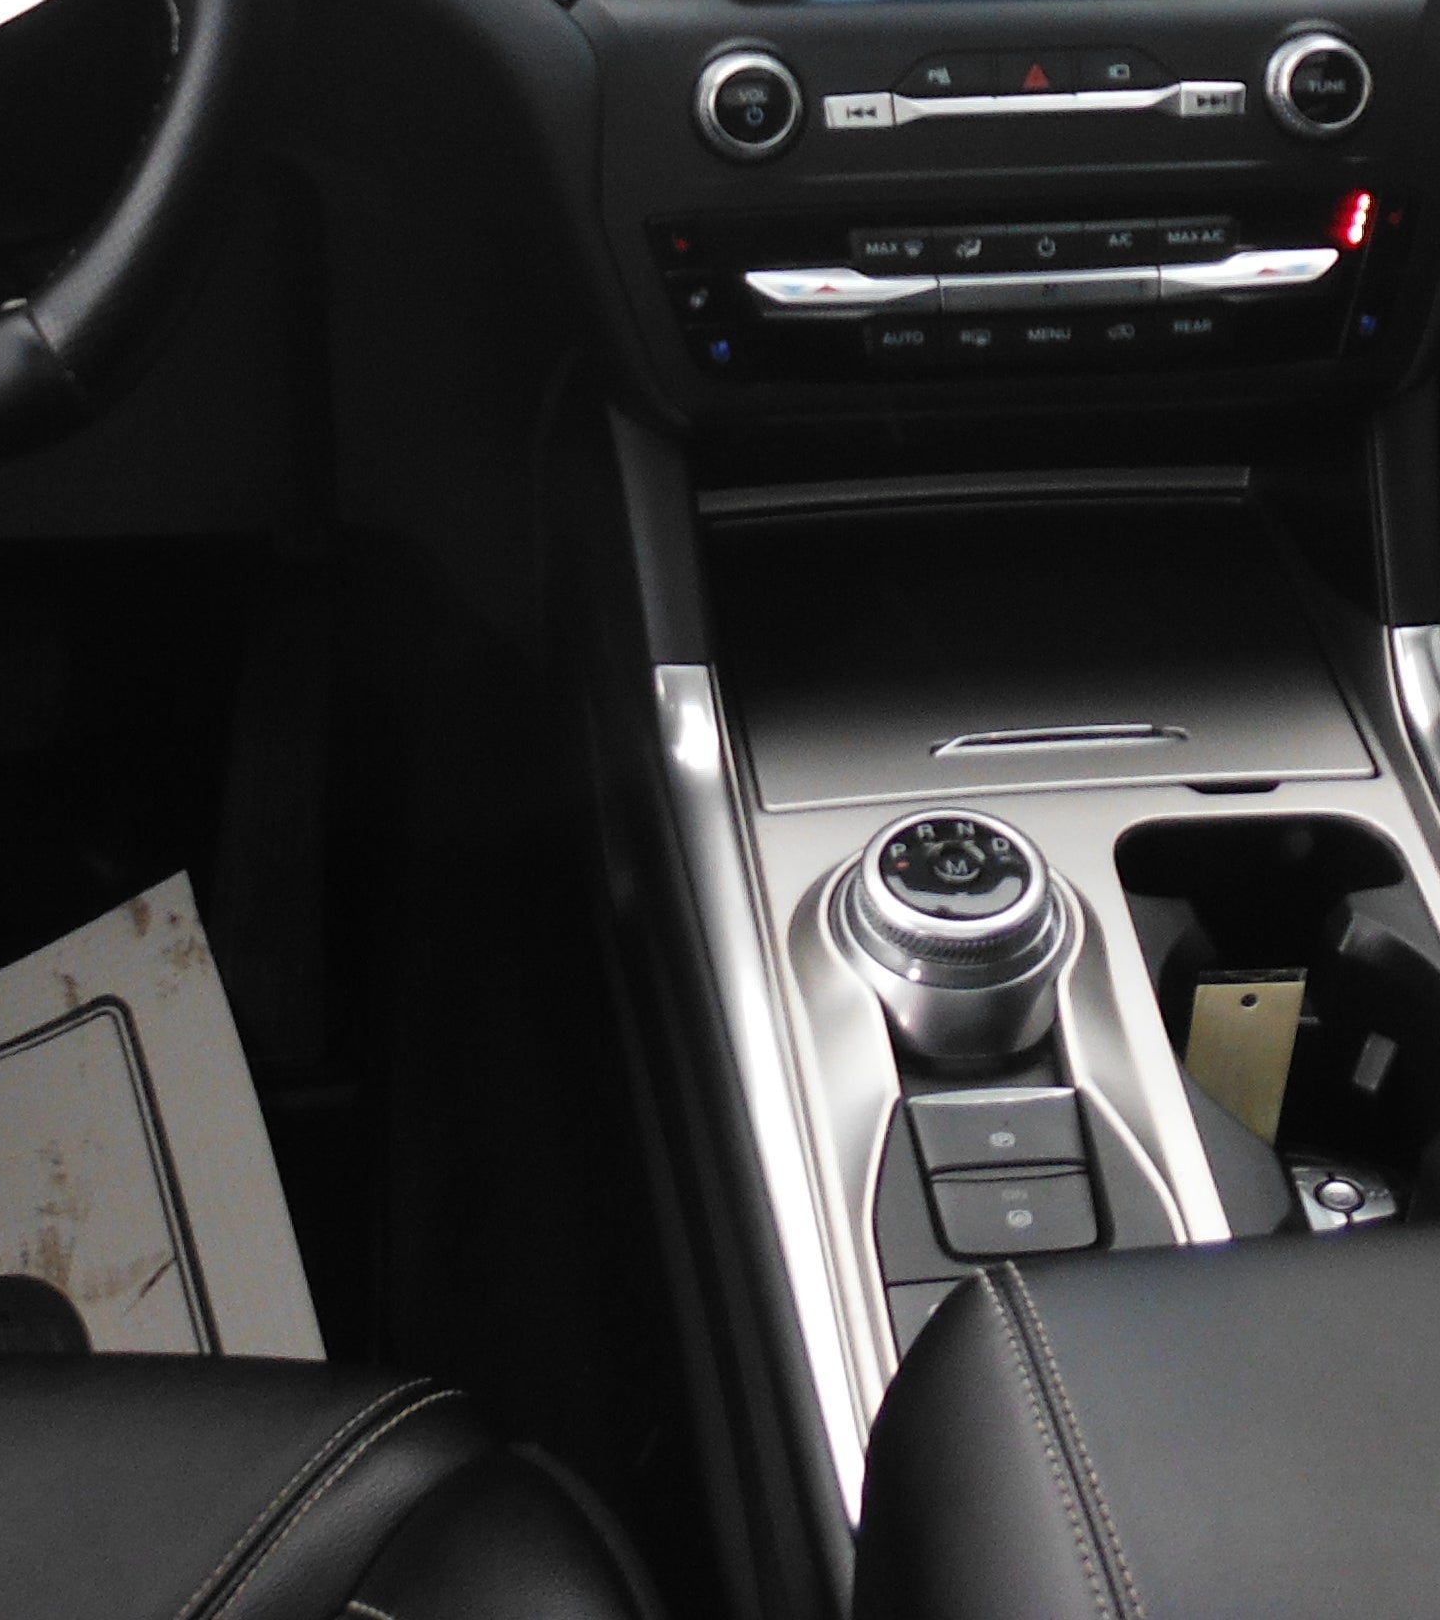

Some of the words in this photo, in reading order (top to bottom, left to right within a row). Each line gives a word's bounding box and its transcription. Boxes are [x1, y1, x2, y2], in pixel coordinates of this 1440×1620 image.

[865, 241, 898, 256] MAX
[882, 331, 925, 345] AUTO
[1027, 328, 1073, 342] MENU
[917, 823, 935, 839] R
[957, 822, 976, 836] N
[889, 843, 907, 858] P
[991, 836, 1011, 853] D
[944, 859, 968, 876] M
